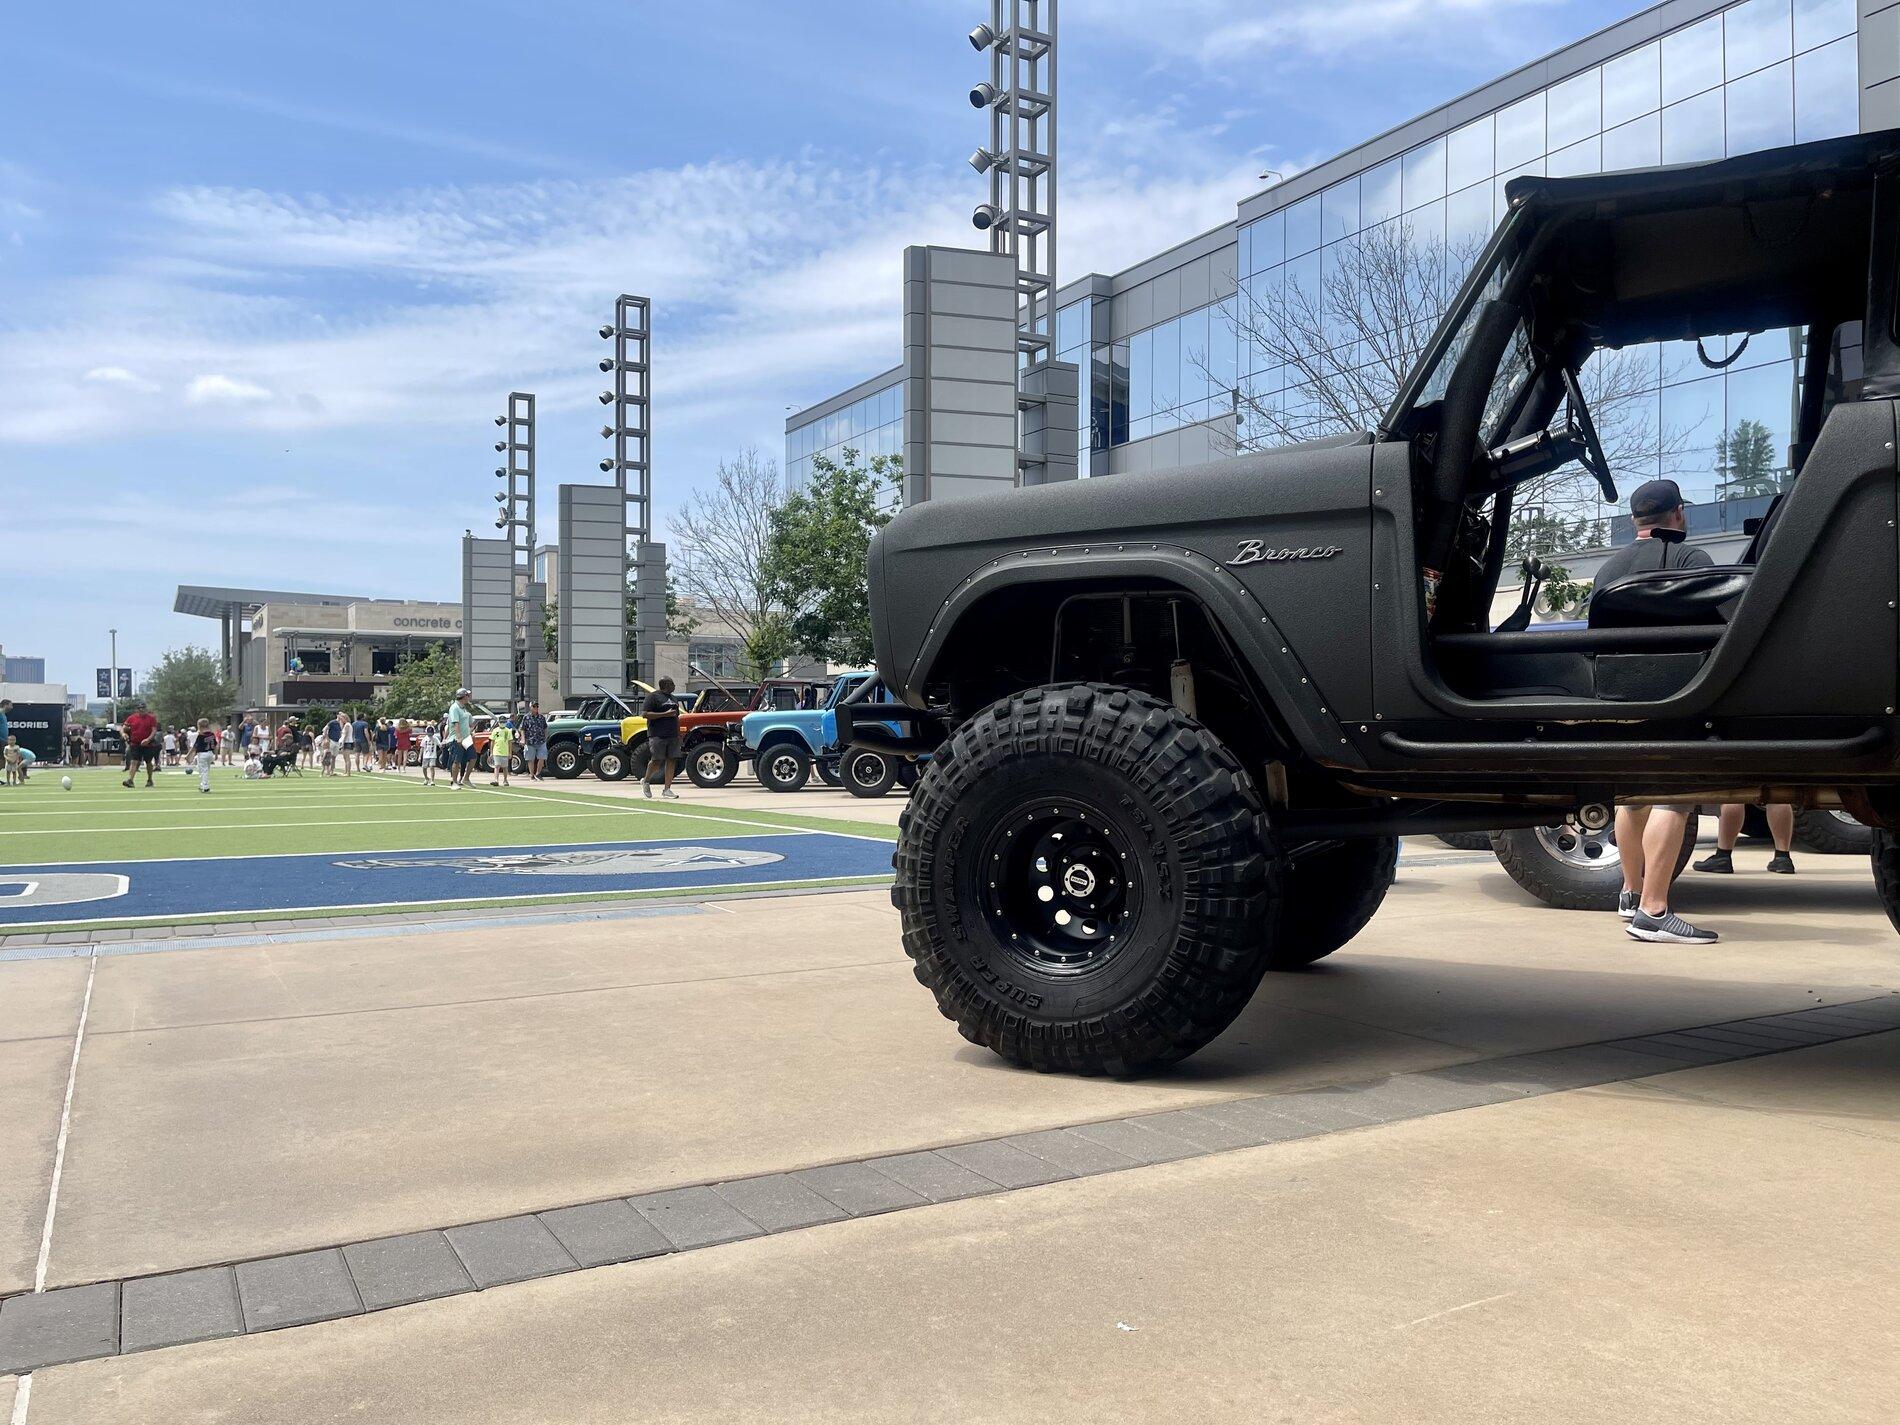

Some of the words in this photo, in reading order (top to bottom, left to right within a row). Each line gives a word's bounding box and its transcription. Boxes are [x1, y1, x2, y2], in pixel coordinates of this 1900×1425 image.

[1226, 539, 1343, 566] Bronco
[393, 617, 451, 629] concrete
[943, 815, 970, 943] SWAMPER
[970, 955, 1043, 1009] SUPER
